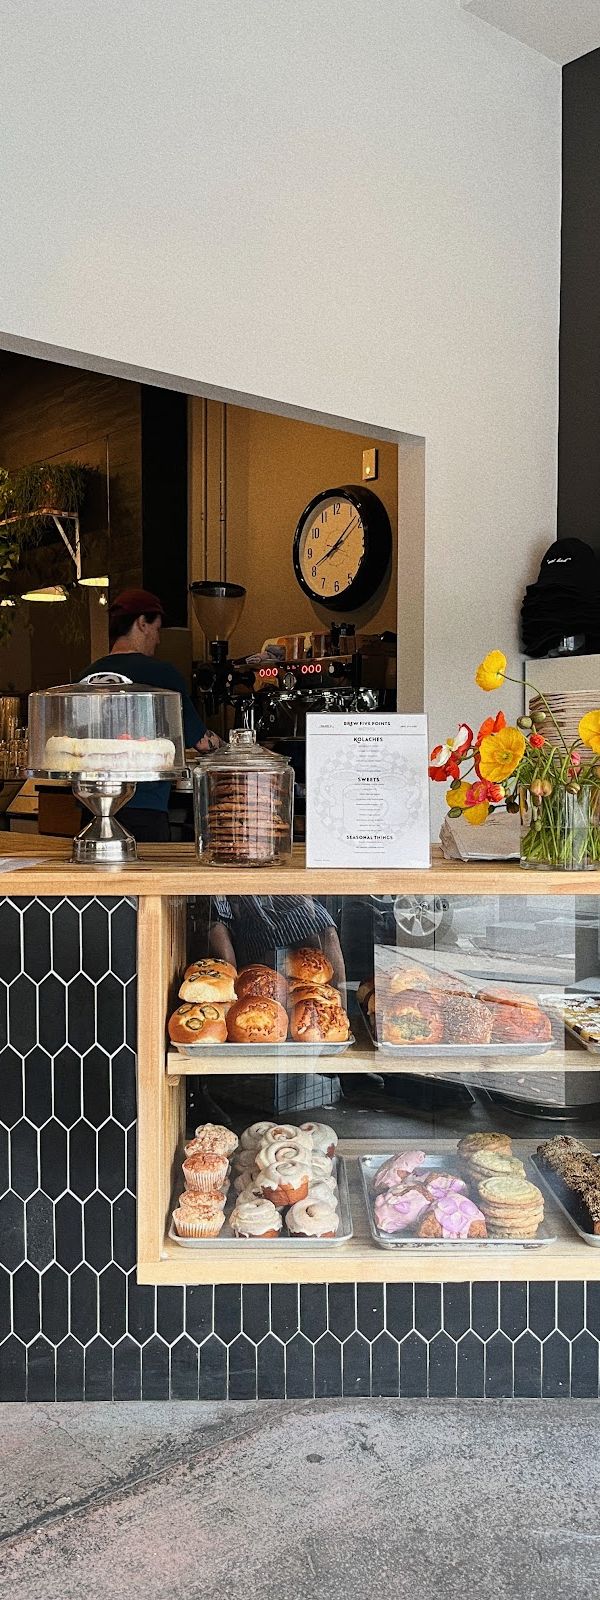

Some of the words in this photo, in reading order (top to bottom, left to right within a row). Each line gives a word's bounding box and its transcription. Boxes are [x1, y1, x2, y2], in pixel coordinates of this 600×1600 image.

[333, 503, 341, 516] 12
[321, 511, 328, 524] 11
[311, 528, 320, 540] 10
[307, 547, 313, 559] 9
[311, 565, 317, 577] 8
[321, 578, 326, 589] 7
[347, 573, 353, 585] 5
[334, 581, 340, 593] 6
